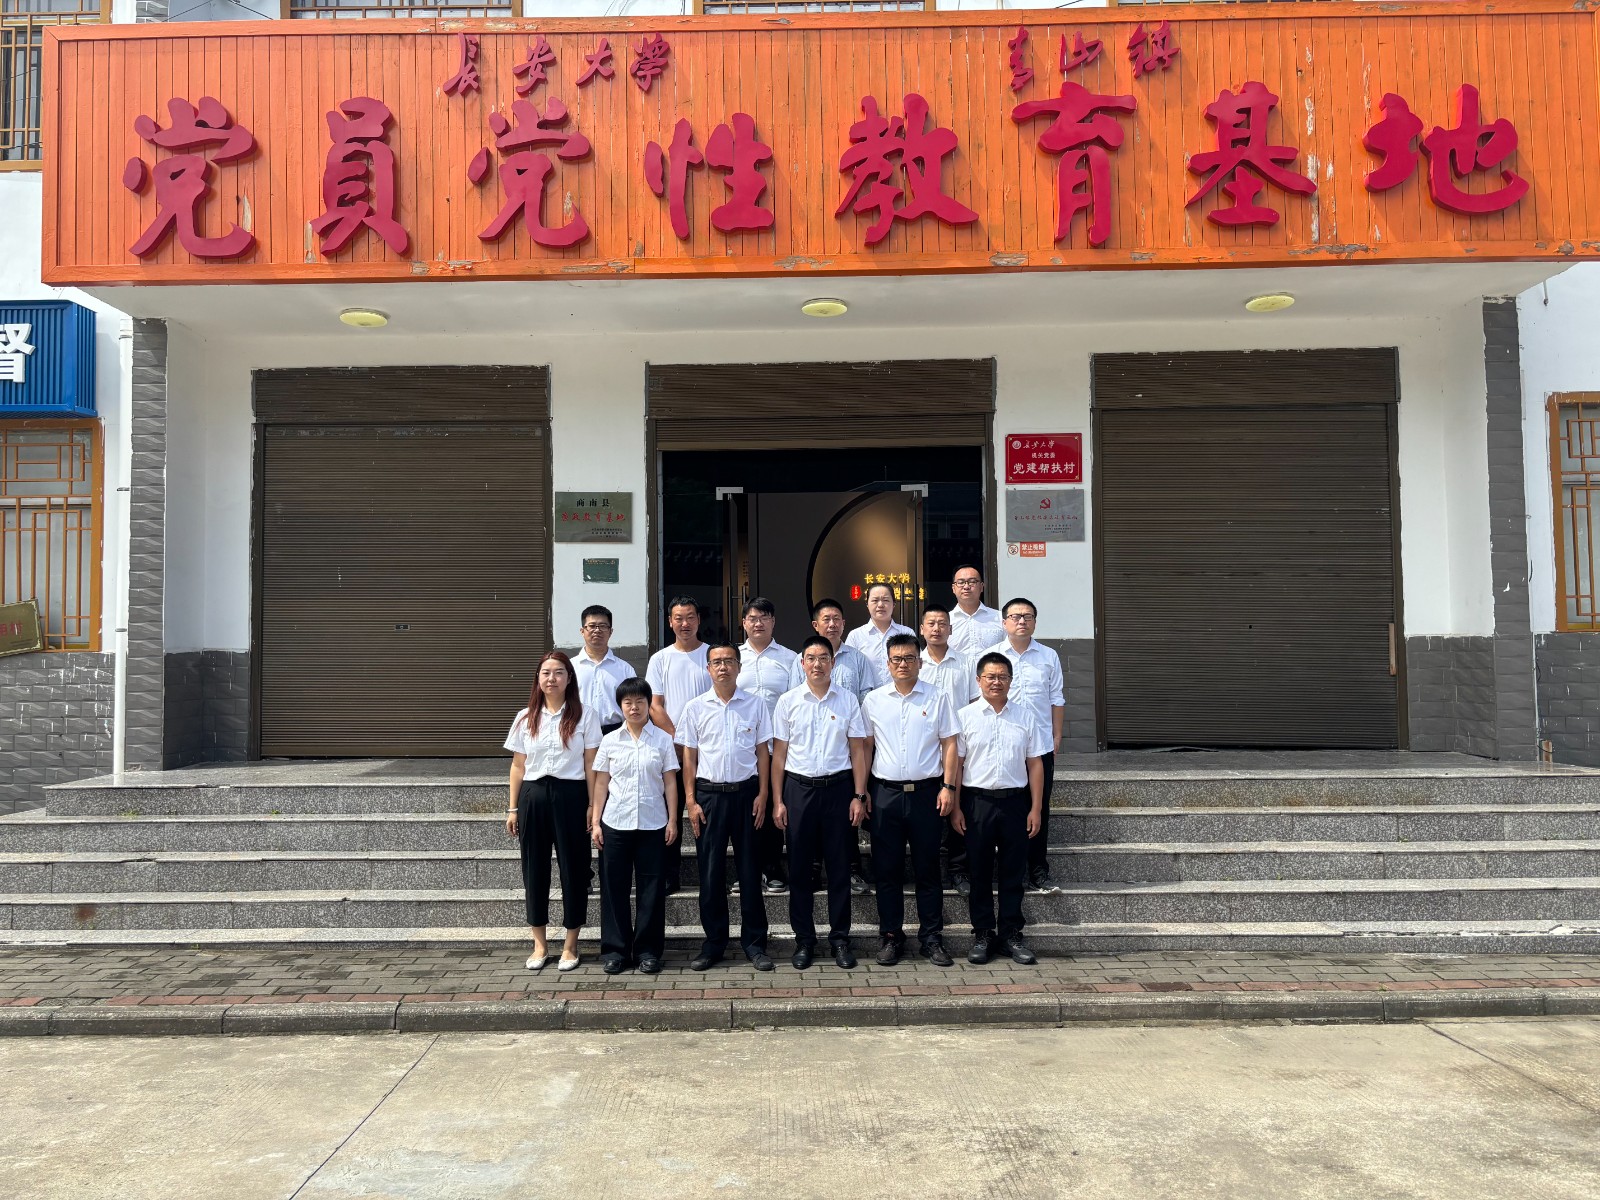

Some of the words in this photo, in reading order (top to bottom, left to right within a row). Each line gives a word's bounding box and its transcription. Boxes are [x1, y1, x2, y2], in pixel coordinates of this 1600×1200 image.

[1012, 462, 1075, 474] 党建帮扶村
[576, 498, 610, 507] 商南县
[864, 573, 911, 584] 长安大学
